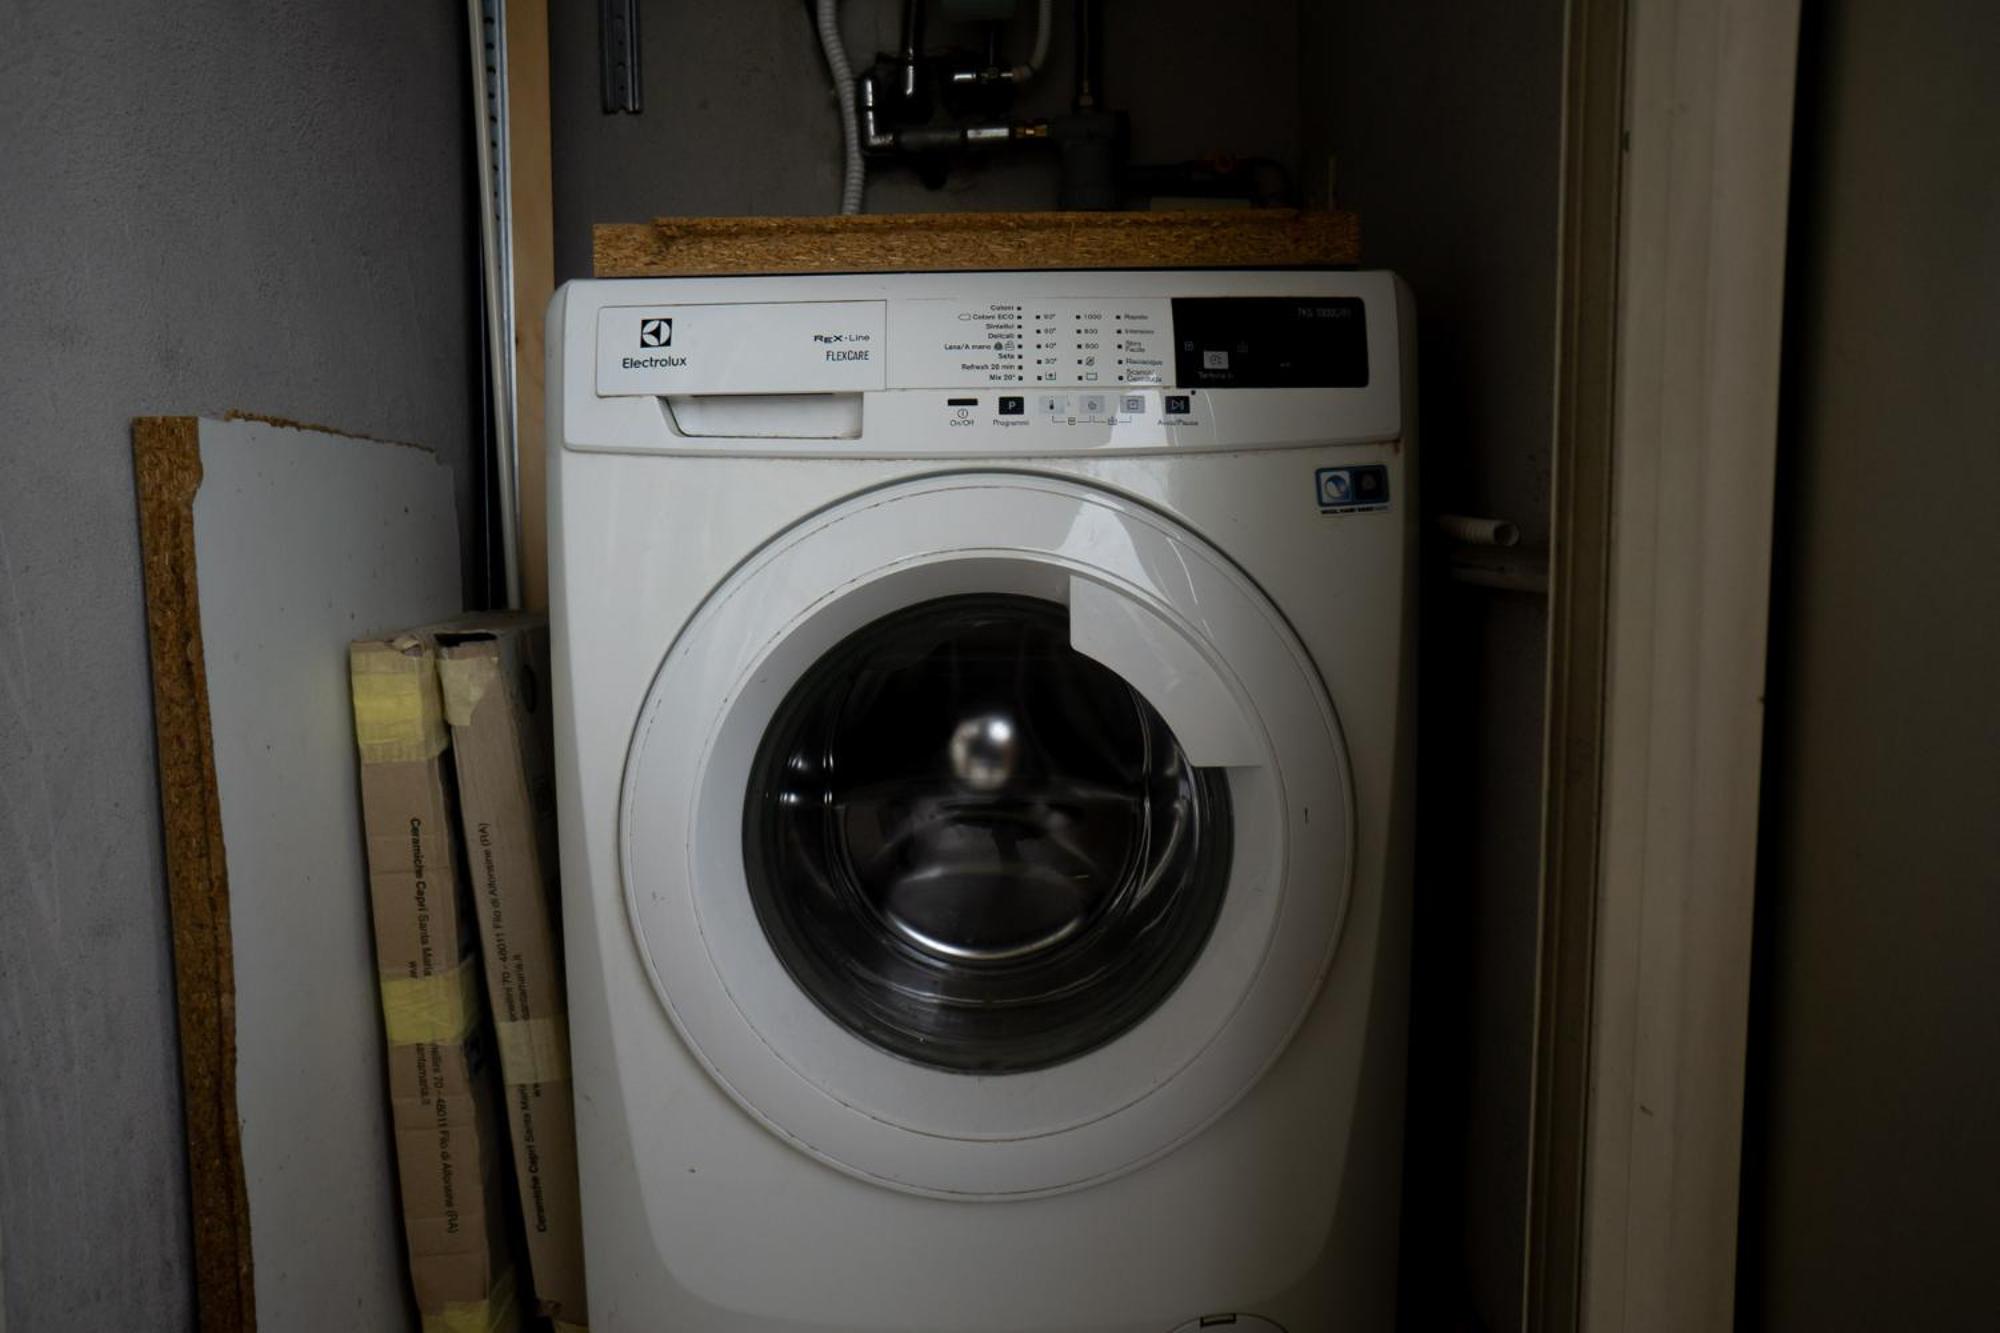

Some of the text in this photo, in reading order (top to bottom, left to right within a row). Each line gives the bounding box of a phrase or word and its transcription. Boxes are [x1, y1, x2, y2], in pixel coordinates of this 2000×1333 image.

[622, 356, 687, 369] Electrolux
[826, 350, 870, 361] FLEXCARE
[1009, 401, 1017, 410] P
[478, 823, 492, 846] (RA)
[410, 818, 425, 878] Ceramiche
[484, 849, 497, 897] Alfonsine
[414, 881, 429, 911] Capri
[490, 899, 500, 908] di
[418, 914, 431, 944] Santa
[491, 910, 503, 929] Filo
[496, 932, 509, 963] 48011
[422, 947, 434, 976] Maria
[501, 972, 512, 985] 70
[432, 1074, 443, 1088] 70
[436, 1098, 449, 1128] 48011
[439, 1130, 451, 1150] Filo
[523, 1113, 535, 1143] Santa
[441, 1151, 451, 1161] di
[525, 1145, 540, 1173] Capri
[442, 1162, 456, 1207] Alfonsine
[530, 1176, 547, 1233] Ceramiche
[446, 1210, 459, 1234] (RA)
